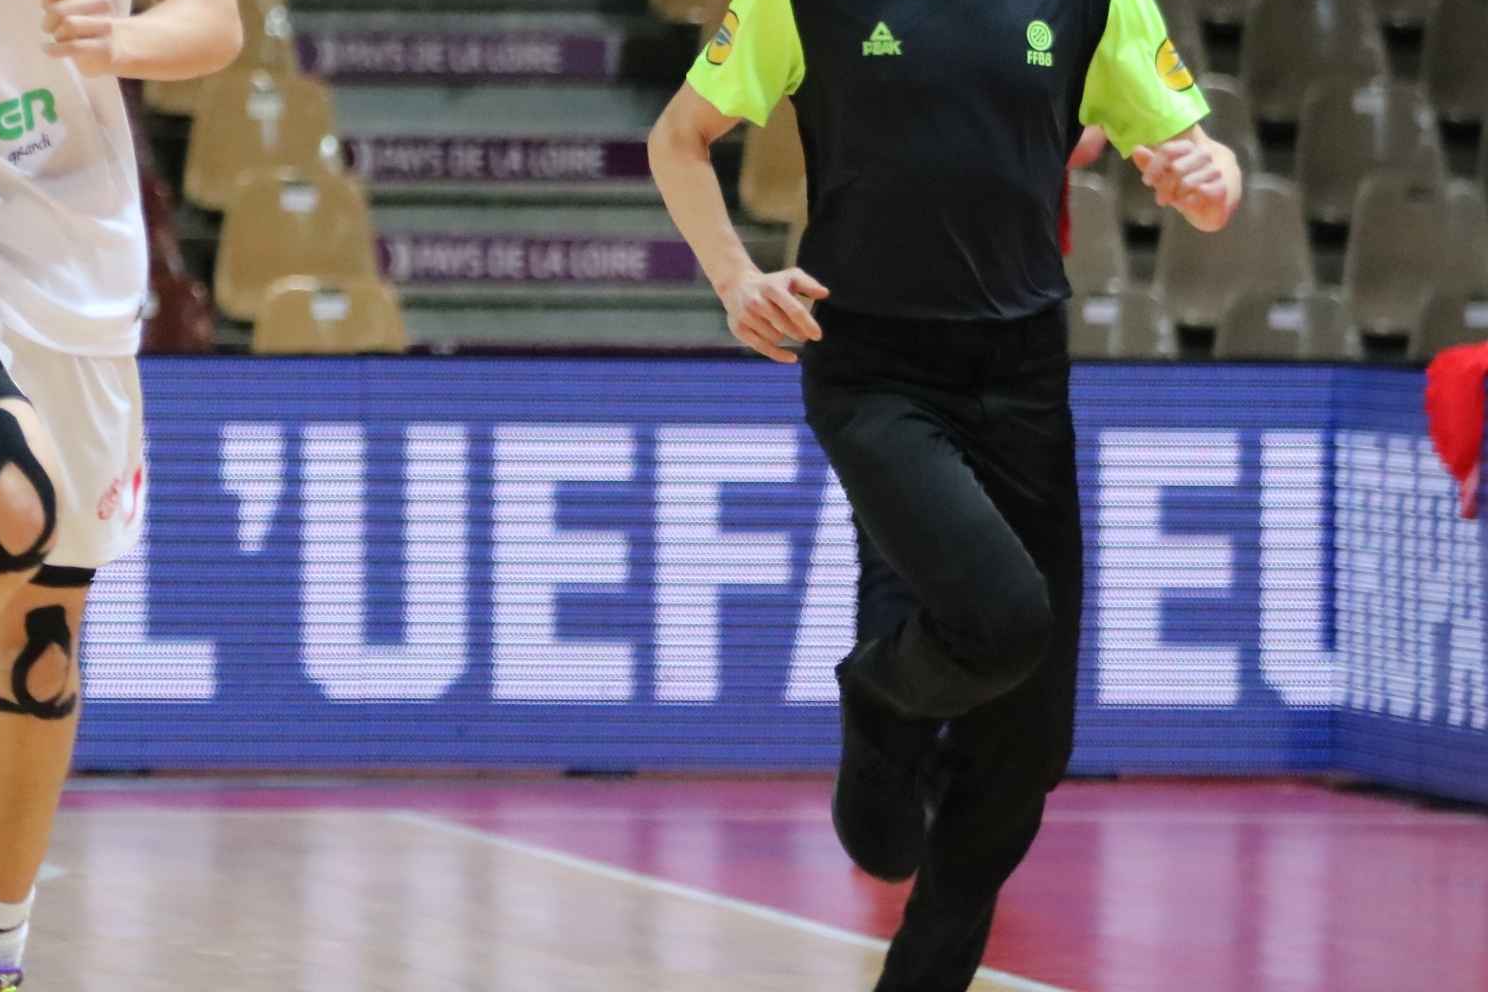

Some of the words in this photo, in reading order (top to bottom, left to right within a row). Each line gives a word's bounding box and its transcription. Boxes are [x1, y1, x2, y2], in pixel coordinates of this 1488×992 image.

[336, 41, 404, 73] PAYS
[409, 41, 445, 73] DE
[449, 41, 482, 73] LA
[487, 41, 562, 73] LOIRE
[863, 41, 902, 55] PEAK
[376, 144, 443, 178] PAYS
[448, 144, 484, 178] DE
[488, 144, 523, 178] LA
[529, 144, 605, 178] LOIRE
[411, 244, 481, 279] PAYS
[486, 244, 526, 279] DE
[529, 244, 565, 279] LA
[571, 244, 648, 279] LOIRE
